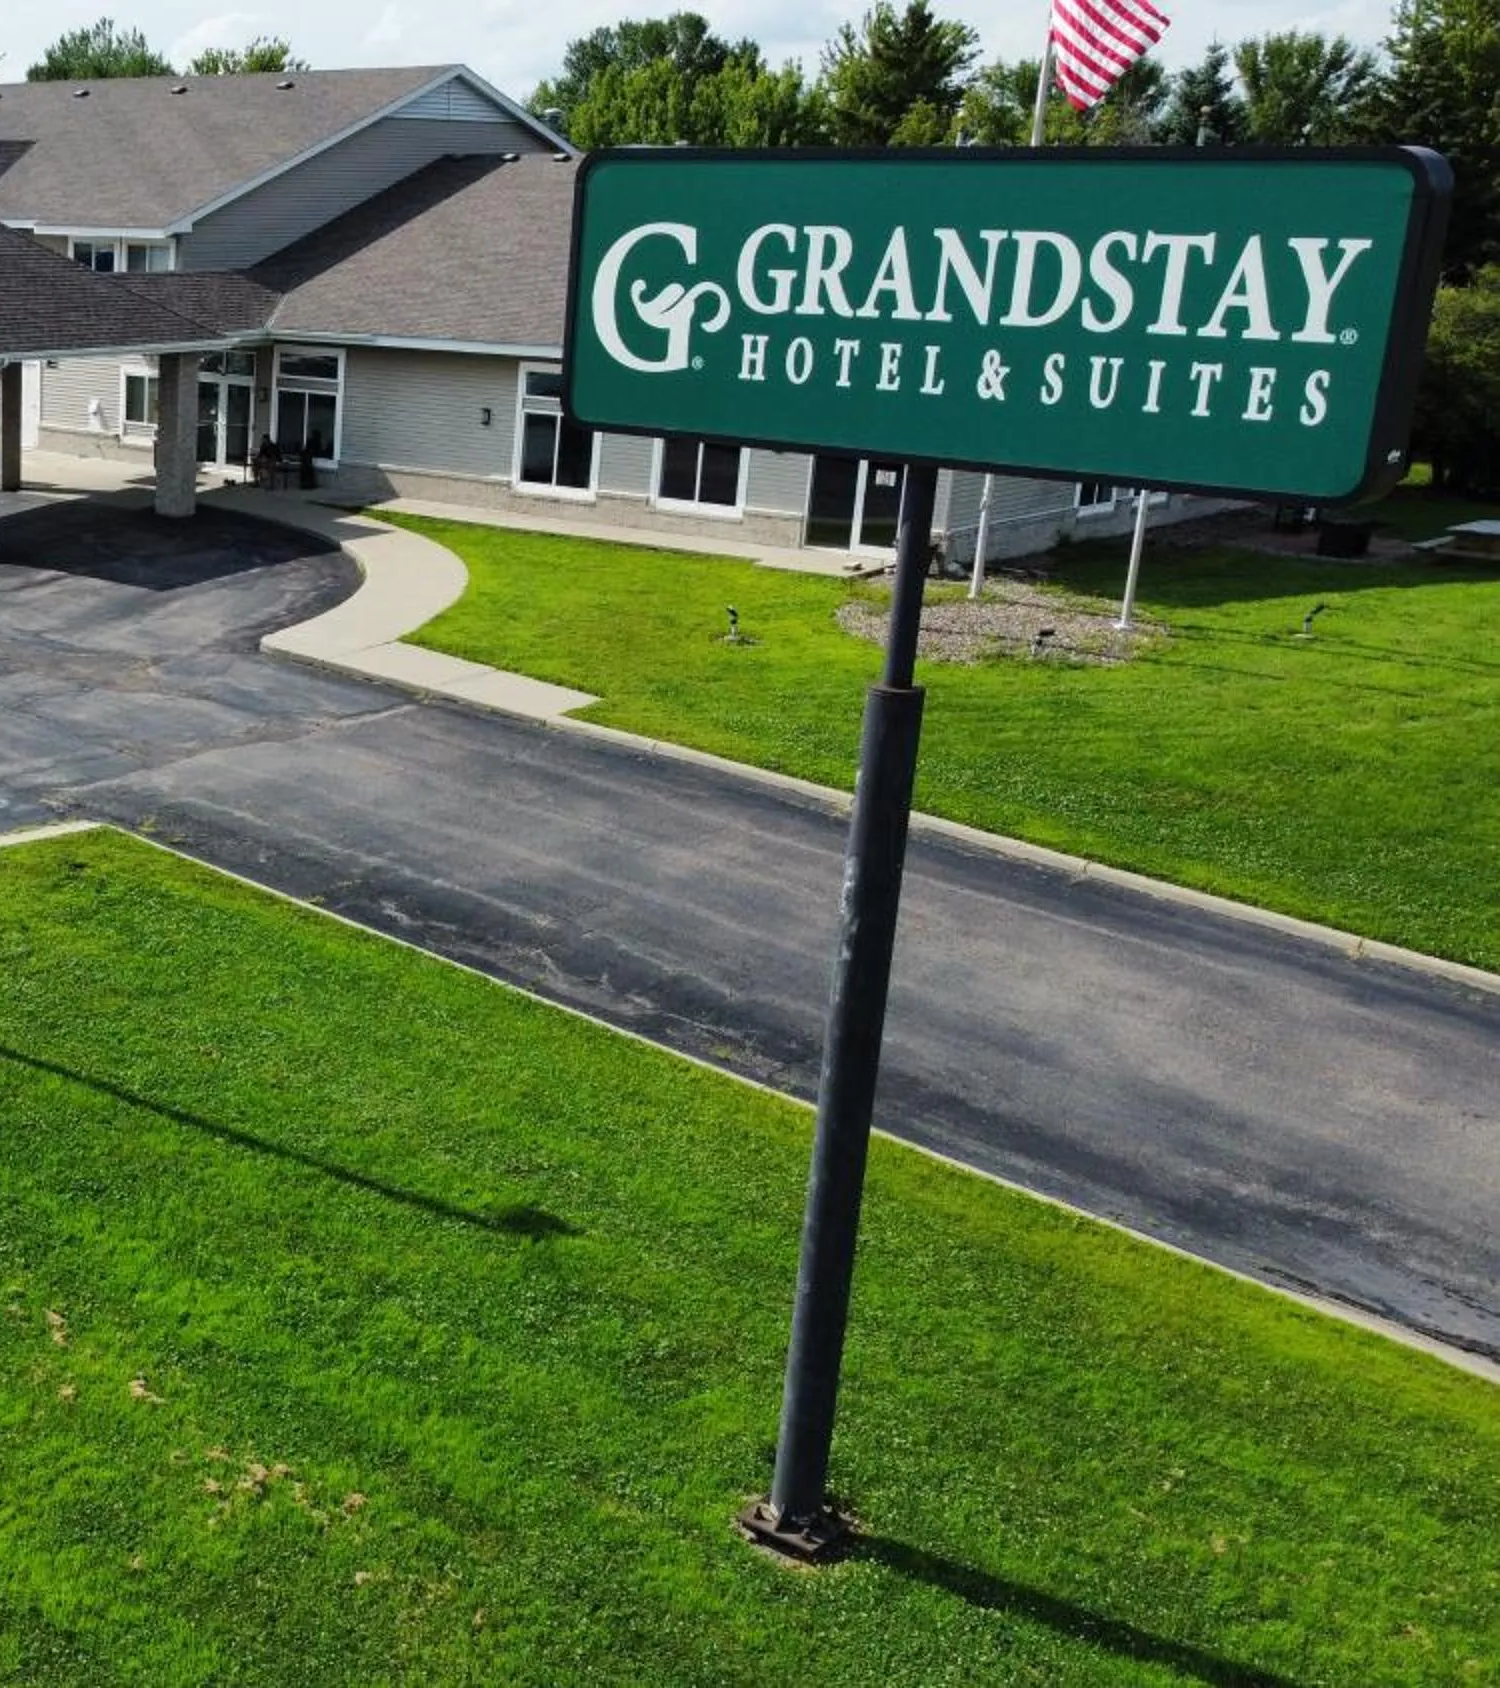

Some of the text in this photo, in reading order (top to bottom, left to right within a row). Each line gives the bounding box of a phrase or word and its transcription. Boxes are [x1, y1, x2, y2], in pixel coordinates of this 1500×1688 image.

[738, 334, 1330, 426] HOTEL & SUITES
